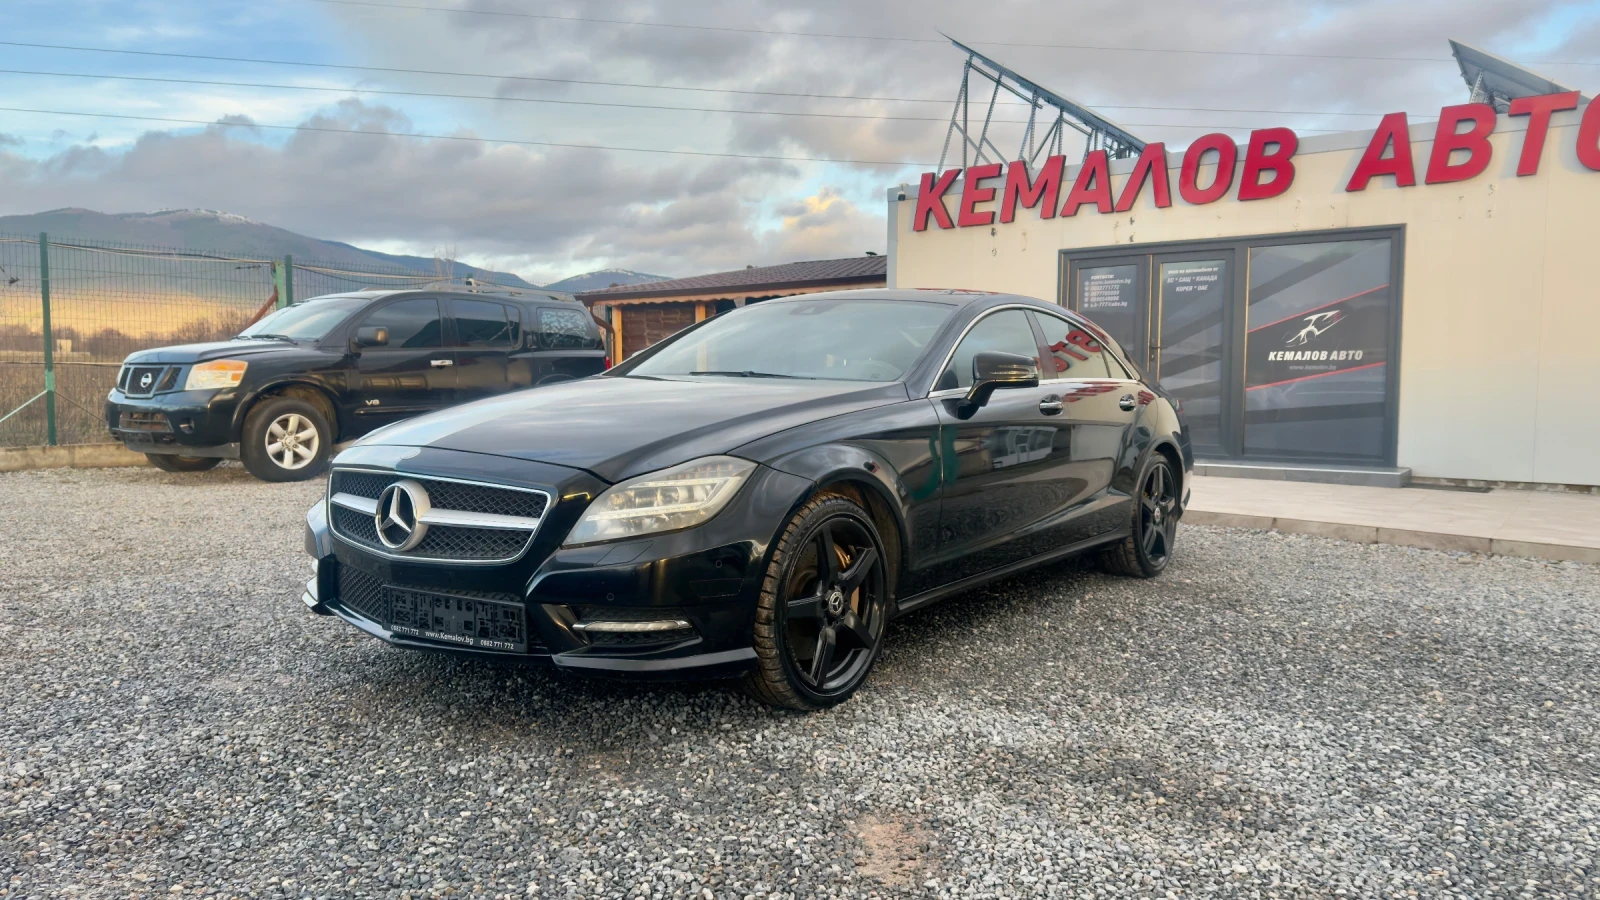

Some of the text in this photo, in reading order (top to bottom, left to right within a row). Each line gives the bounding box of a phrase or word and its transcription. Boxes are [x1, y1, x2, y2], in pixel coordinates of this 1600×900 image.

[913, 127, 1298, 232] КЕМАЛОВ
[1268, 350, 1363, 361] КЕМАЛОВ АВТО
[402, 626, 410, 634] 771
[410, 627, 419, 635] 772
[425, 631, 474, 645] www.Kemalov.bg
